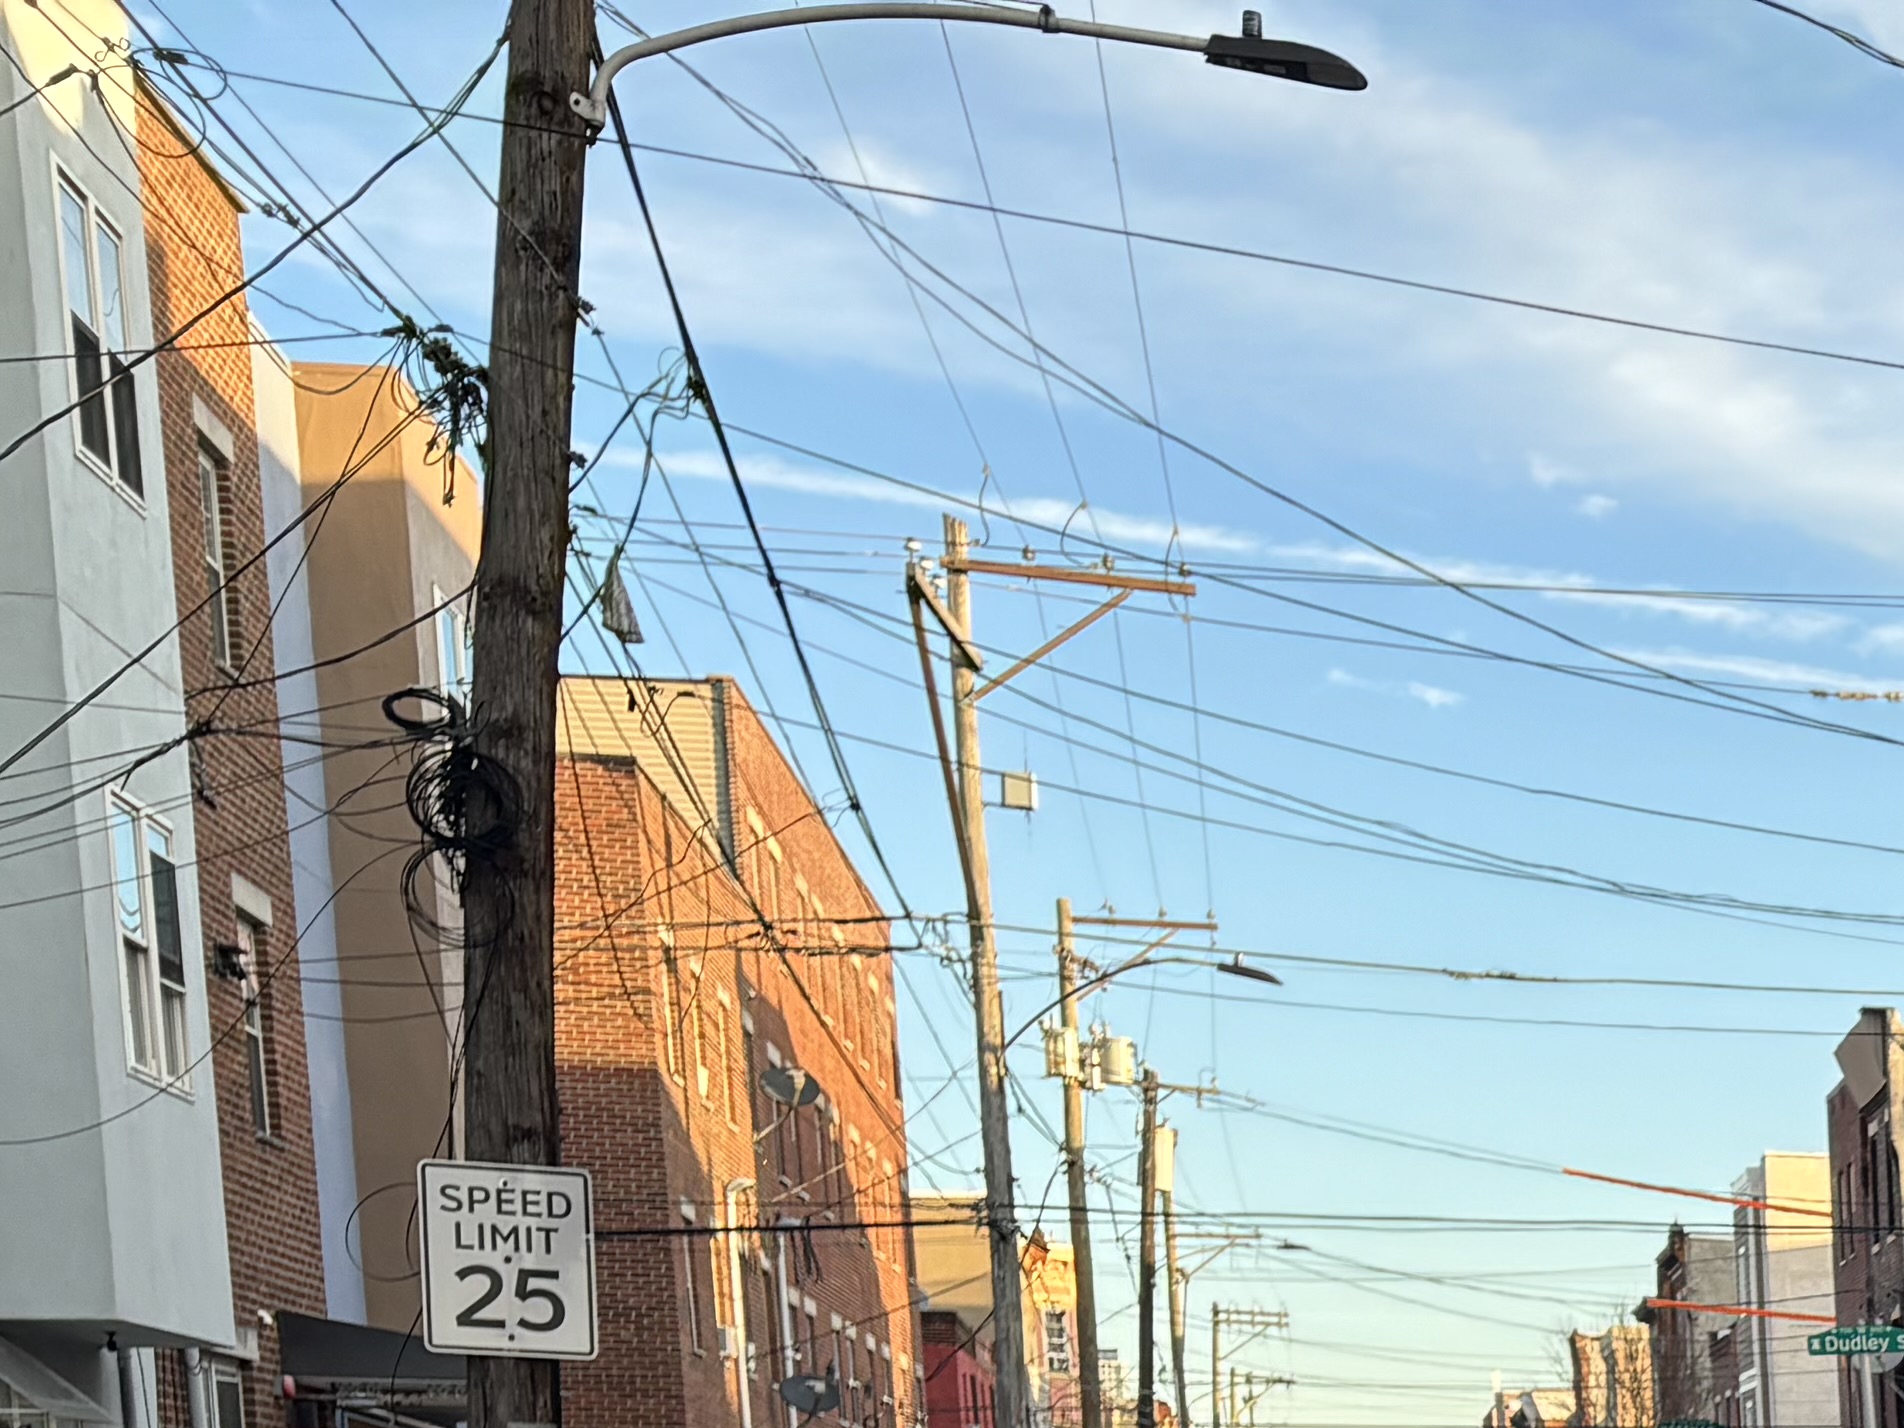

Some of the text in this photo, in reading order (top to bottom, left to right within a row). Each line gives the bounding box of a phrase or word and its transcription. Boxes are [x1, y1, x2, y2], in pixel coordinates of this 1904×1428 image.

[439, 1184, 572, 1219] SPEED
[455, 1221, 559, 1255] LIMIT
[454, 1264, 566, 1332] 25
[1824, 1334, 1889, 1353] Dudley
